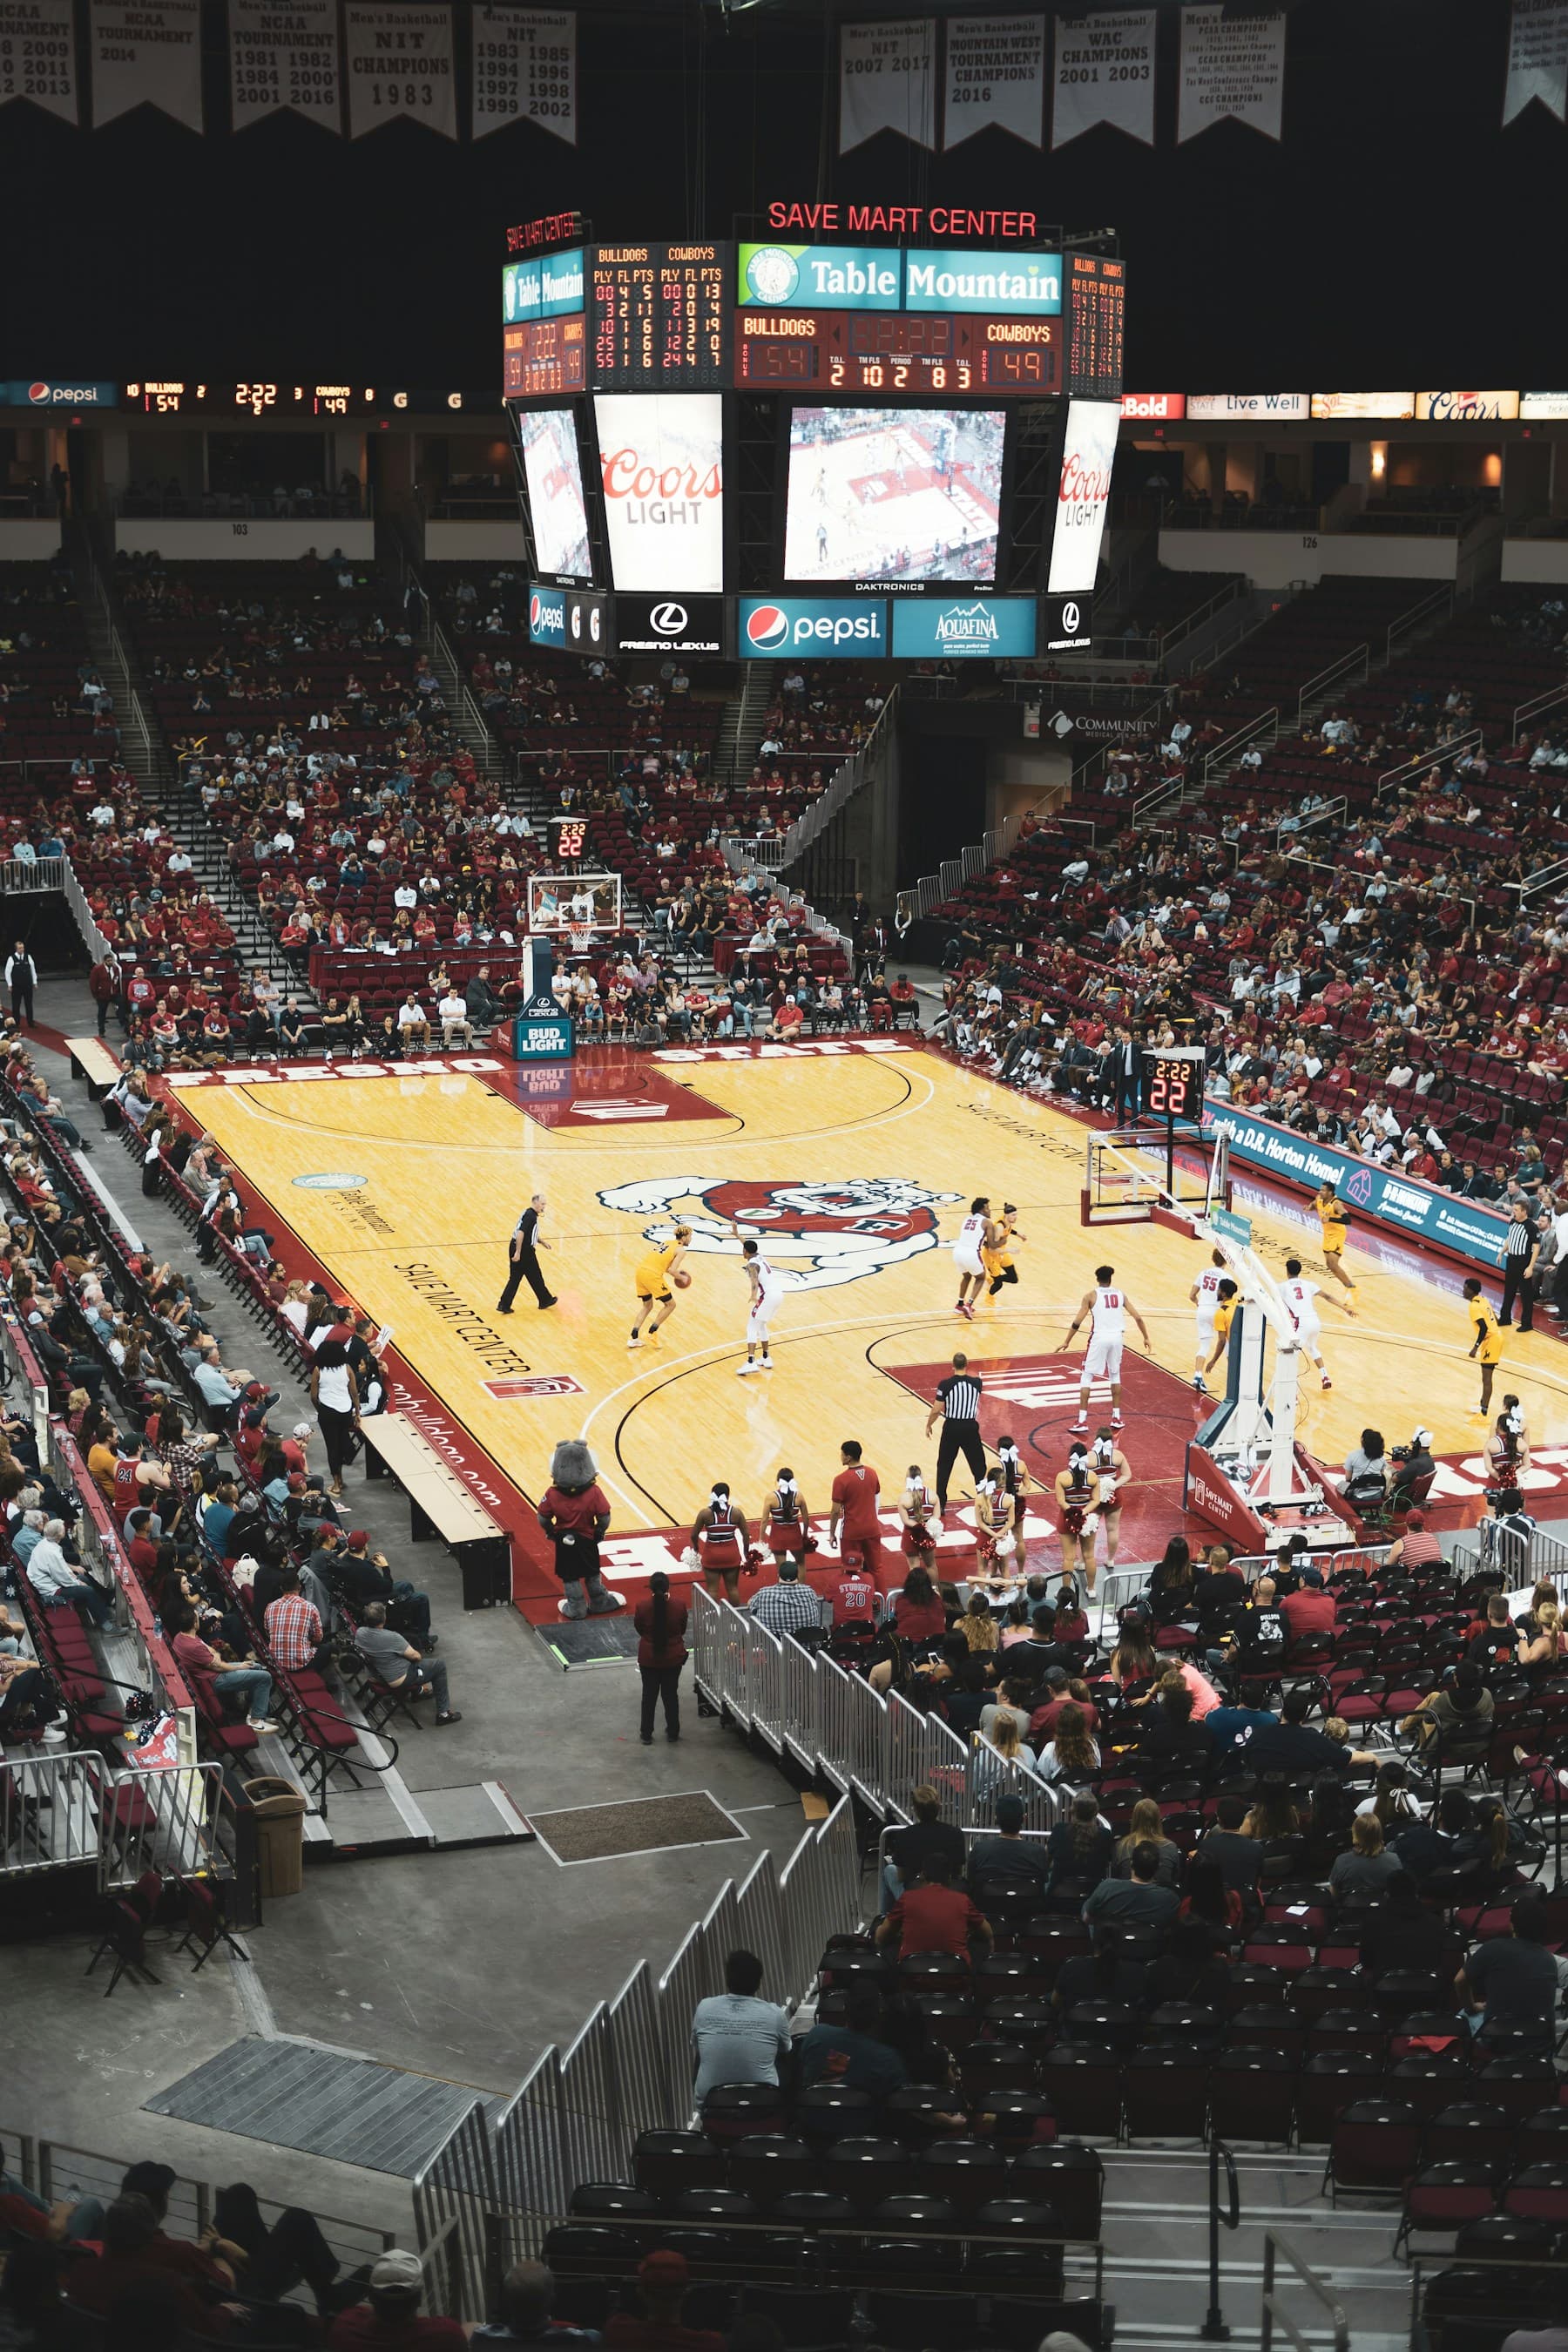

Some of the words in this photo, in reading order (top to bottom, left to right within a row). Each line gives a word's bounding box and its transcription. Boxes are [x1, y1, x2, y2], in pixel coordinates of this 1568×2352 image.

[260, 16, 307, 30] NCAA
[98, 27, 193, 43] TOURNAMENT
[233, 31, 334, 47] TOURNAMENT
[375, 32, 425, 49] NIT
[508, 27, 537, 43] NIT
[1089, 32, 1121, 45] WAC
[23, 42, 68, 56] 2009
[872, 41, 899, 55] NIT
[950, 37, 1008, 51] MOUNTAIN
[1011, 37, 1040, 48] WEST
[100, 48, 135, 61] 2014
[234, 51, 277, 66] 1981
[289, 52, 331, 67] 1982
[477, 44, 518, 57] 1983
[529, 46, 569, 61] 1985
[950, 51, 1040, 66] TOURNAMENT
[1063, 47, 1148, 63] CHAMPIONS
[24, 59, 67, 75] 2011
[354, 57, 449, 74] CHAMPIONS
[477, 62, 518, 77] 1994
[529, 65, 569, 79] 1996
[846, 59, 882, 74] 2007
[892, 56, 929, 71] 2017
[236, 71, 279, 84] 1984
[956, 66, 1035, 82] CHAMPIONS
[1060, 69, 1098, 83] 2001
[1109, 66, 1149, 81] 2003
[25, 79, 70, 95] 2013
[373, 84, 433, 105] 1983
[477, 80, 517, 96] 1997
[529, 83, 569, 98] 1998
[238, 89, 280, 104] 2001
[291, 89, 334, 105] 2016
[952, 88, 990, 103] 2016
[477, 99, 518, 113] 1999
[529, 101, 571, 116] 2002
[769, 202, 838, 228] SAVE
[848, 206, 923, 232] MART
[929, 208, 1036, 236] CENTER
[598, 248, 647, 261] BULLDOGS
[668, 247, 714, 260] COWBOYS
[594, 270, 612, 283] PLY
[618, 270, 630, 282] FL
[633, 269, 653, 282] PTS
[661, 268, 679, 282] PLY
[686, 268, 697, 281] FL
[701, 267, 721, 280] PTS
[811, 261, 896, 294] Table
[909, 265, 1058, 300] Mountain
[518, 276, 540, 307] Table
[543, 271, 584, 302] Mountain
[596, 286, 614, 301] 00
[663, 285, 680, 299] 00
[706, 284, 720, 298] 13
[638, 303, 652, 315] 11
[686, 302, 695, 317] 0
[711, 302, 720, 314] 4
[601, 320, 613, 334] 10
[643, 320, 652, 334] 6
[667, 320, 680, 333] 11
[687, 319, 695, 334] 3
[706, 319, 719, 332] 19
[744, 319, 815, 335] BULLDOGS
[988, 325, 1050, 342] COWBOYS
[597, 337, 613, 351] 25
[643, 336, 652, 351] 6
[667, 336, 680, 349] 12
[686, 335, 695, 350] 2
[710, 335, 719, 349] 0
[597, 354, 613, 368] 55
[643, 353, 652, 368] 6
[664, 353, 680, 366] 24
[686, 353, 695, 365] 4
[710, 353, 719, 365] 7
[1005, 353, 1040, 381] 49
[831, 365, 844, 386] 2
[863, 366, 882, 387] 10
[894, 367, 908, 387] 2
[933, 368, 946, 389] 8
[958, 368, 970, 389] 3
[53, 387, 98, 402] pepsi
[145, 383, 184, 393] BULLDOGS
[198, 386, 206, 398] 2
[236, 384, 276, 404] 2:22
[294, 388, 302, 400] 3
[316, 386, 350, 396] COWBOYS
[365, 389, 374, 401] 8
[157, 395, 179, 412] 54
[325, 398, 346, 414] 49
[1191, 402, 1214, 410] STATE
[1227, 396, 1258, 409] Live
[1265, 395, 1299, 409] Well
[1429, 392, 1502, 420] Coors
[599, 449, 722, 499] Coors
[1058, 453, 1112, 503] Coors
[627, 502, 702, 524] LIGHT
[1064, 504, 1098, 527] LIGHT
[233, 524, 247, 537] 103
[541, 603, 564, 633] pepsi
[794, 612, 877, 645] pepsi
[935, 614, 999, 640] AQUAFINA
[619, 640, 671, 650] FRESNO
[673, 641, 720, 651] LEXUS
[560, 822, 586, 836] 2:22
[558, 836, 583, 856] 22
[529, 1028, 560, 1040] BUD
[523, 1038, 565, 1051] LIGHT
[652, 1039, 913, 1062] STATE
[161, 1058, 505, 1088] FRESNO
[1156, 1060, 1191, 1082] 2:22
[1150, 1078, 1186, 1113] 22
[1235, 1131, 1245, 1144] a
[1243, 1128, 1265, 1153] D.R.
[1265, 1138, 1305, 1170] Horton
[1305, 1153, 1345, 1185] Home!
[338, 1189, 369, 1204] Table
[324, 1194, 366, 1230] CASINO
[352, 1205, 395, 1233] Mountain
[964, 1220, 978, 1231] 25
[1276, 1247, 1336, 1279] Mountain
[394, 1263, 449, 1290] SAVE
[1202, 1275, 1218, 1292] 55
[1104, 1294, 1119, 1308] 10
[1294, 1287, 1303, 1300] 3
[420, 1291, 484, 1323] MART
[456, 1327, 531, 1375] CENTER
[118, 1469, 132, 1484] 24
[1208, 1502, 1228, 1520] CENTER
[839, 1584, 872, 1593] STUDENT
[846, 1592, 866, 1607] 20
